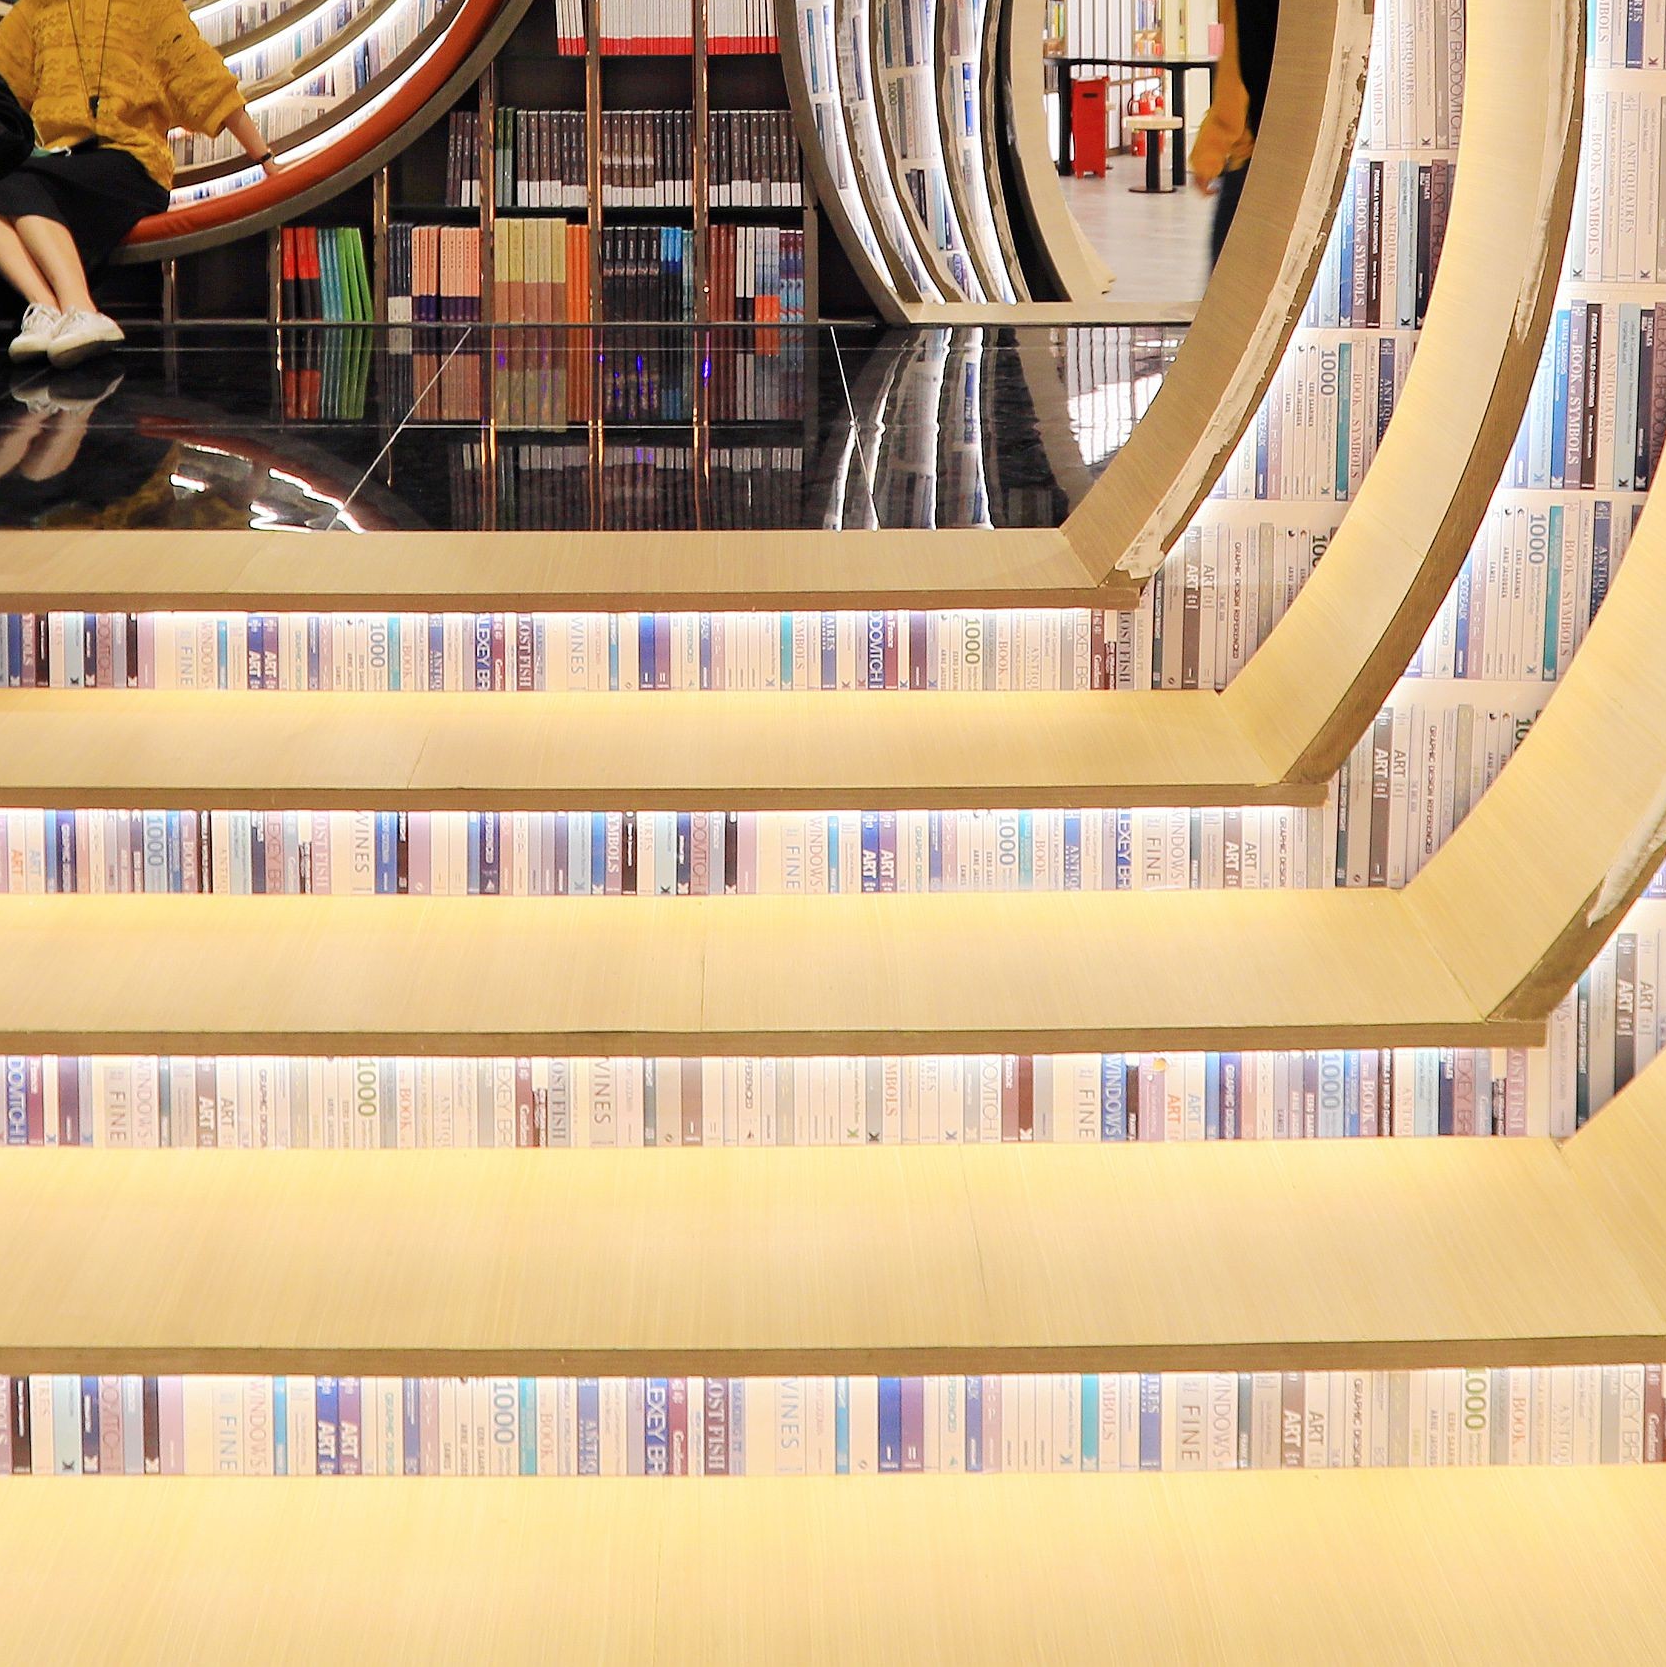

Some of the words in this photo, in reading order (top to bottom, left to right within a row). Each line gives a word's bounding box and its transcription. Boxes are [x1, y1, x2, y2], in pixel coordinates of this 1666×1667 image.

[1625, 140, 1636, 235] ANTIQUAIRES
[1572, 344, 1584, 385] BOOK
[1567, 395, 1582, 465] SYMBOLS
[1186, 564, 1199, 592] ART
[370, 620, 386, 670] 1000
[518, 615, 532, 652] LOST
[571, 616, 584, 676] WINES
[1119, 611, 1132, 647] LOST
[518, 654, 532, 688] FISH
[1119, 649, 1131, 683] FISH
[1374, 747, 1389, 779] ART
[146, 813, 163, 869] 1000
[1145, 837, 1161, 882] FINE
[785, 845, 801, 890] FINE
[356, 1060, 377, 1118] 1000
[109, 1090, 127, 1142] FINE
[493, 1381, 515, 1445] 1000
[1463, 1367, 1488, 1432] 1000
[316, 1420, 334, 1458] ART
[706, 1420, 726, 1471] FISH
[1181, 1405, 1202, 1462] FINE
